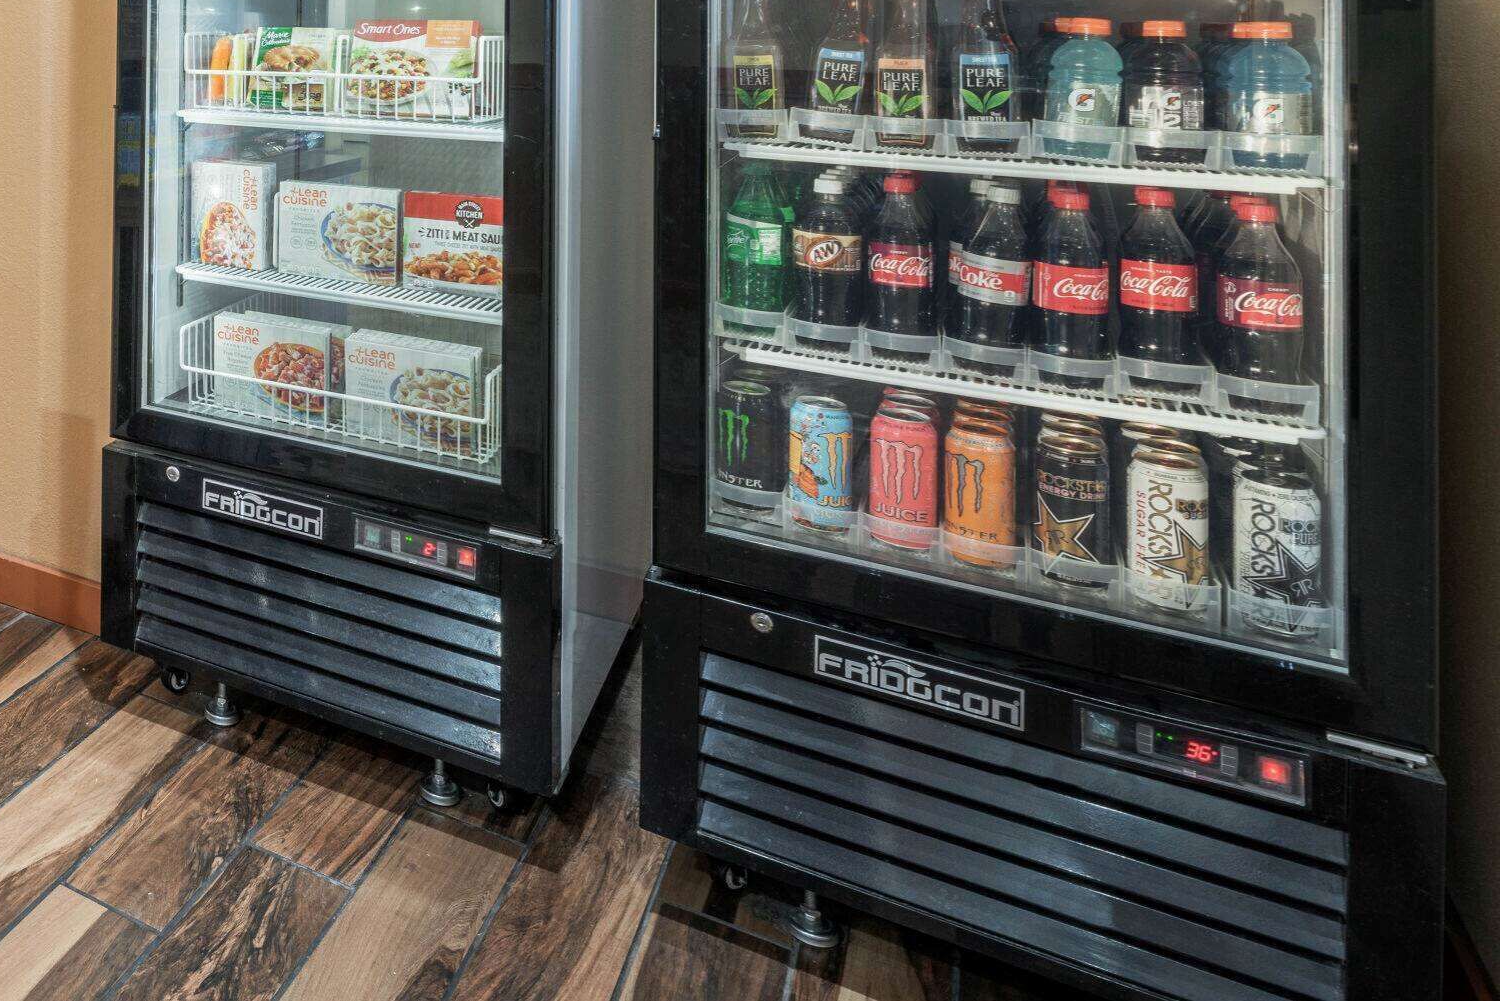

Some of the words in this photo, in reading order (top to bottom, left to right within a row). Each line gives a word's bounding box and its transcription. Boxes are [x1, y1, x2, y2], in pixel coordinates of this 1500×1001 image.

[357, 23, 393, 35] Smart
[393, 24, 420, 35] Ones
[739, 67, 769, 77] PURE
[823, 61, 857, 73] PURE
[966, 68, 1004, 78] PURE
[883, 72, 920, 83] PURE
[243, 169, 251, 210] cuisine
[250, 182, 258, 211] Lean
[299, 188, 328, 198] Lean
[283, 195, 328, 208] cuisine
[456, 210, 483, 219] KITCHEN
[427, 228, 444, 239] ZITI
[453, 231, 479, 242] MEAT
[871, 254, 932, 278] Coca-Cola
[959, 264, 1003, 290] Coke
[1121, 270, 1189, 298] Coca-Cola
[231, 324, 260, 335] Lean
[218, 331, 259, 345] cuisine
[349, 354, 396, 370] cuisine
[362, 349, 395, 361] Lean
[1039, 483, 1077, 498] ENERGY
[875, 503, 928, 523] JUICE
[1136, 490, 1146, 538] SUGAR
[1149, 479, 1173, 556] ROCKS
[1251, 498, 1276, 577] ROCKS
[818, 654, 1020, 726] FRIDGCON
